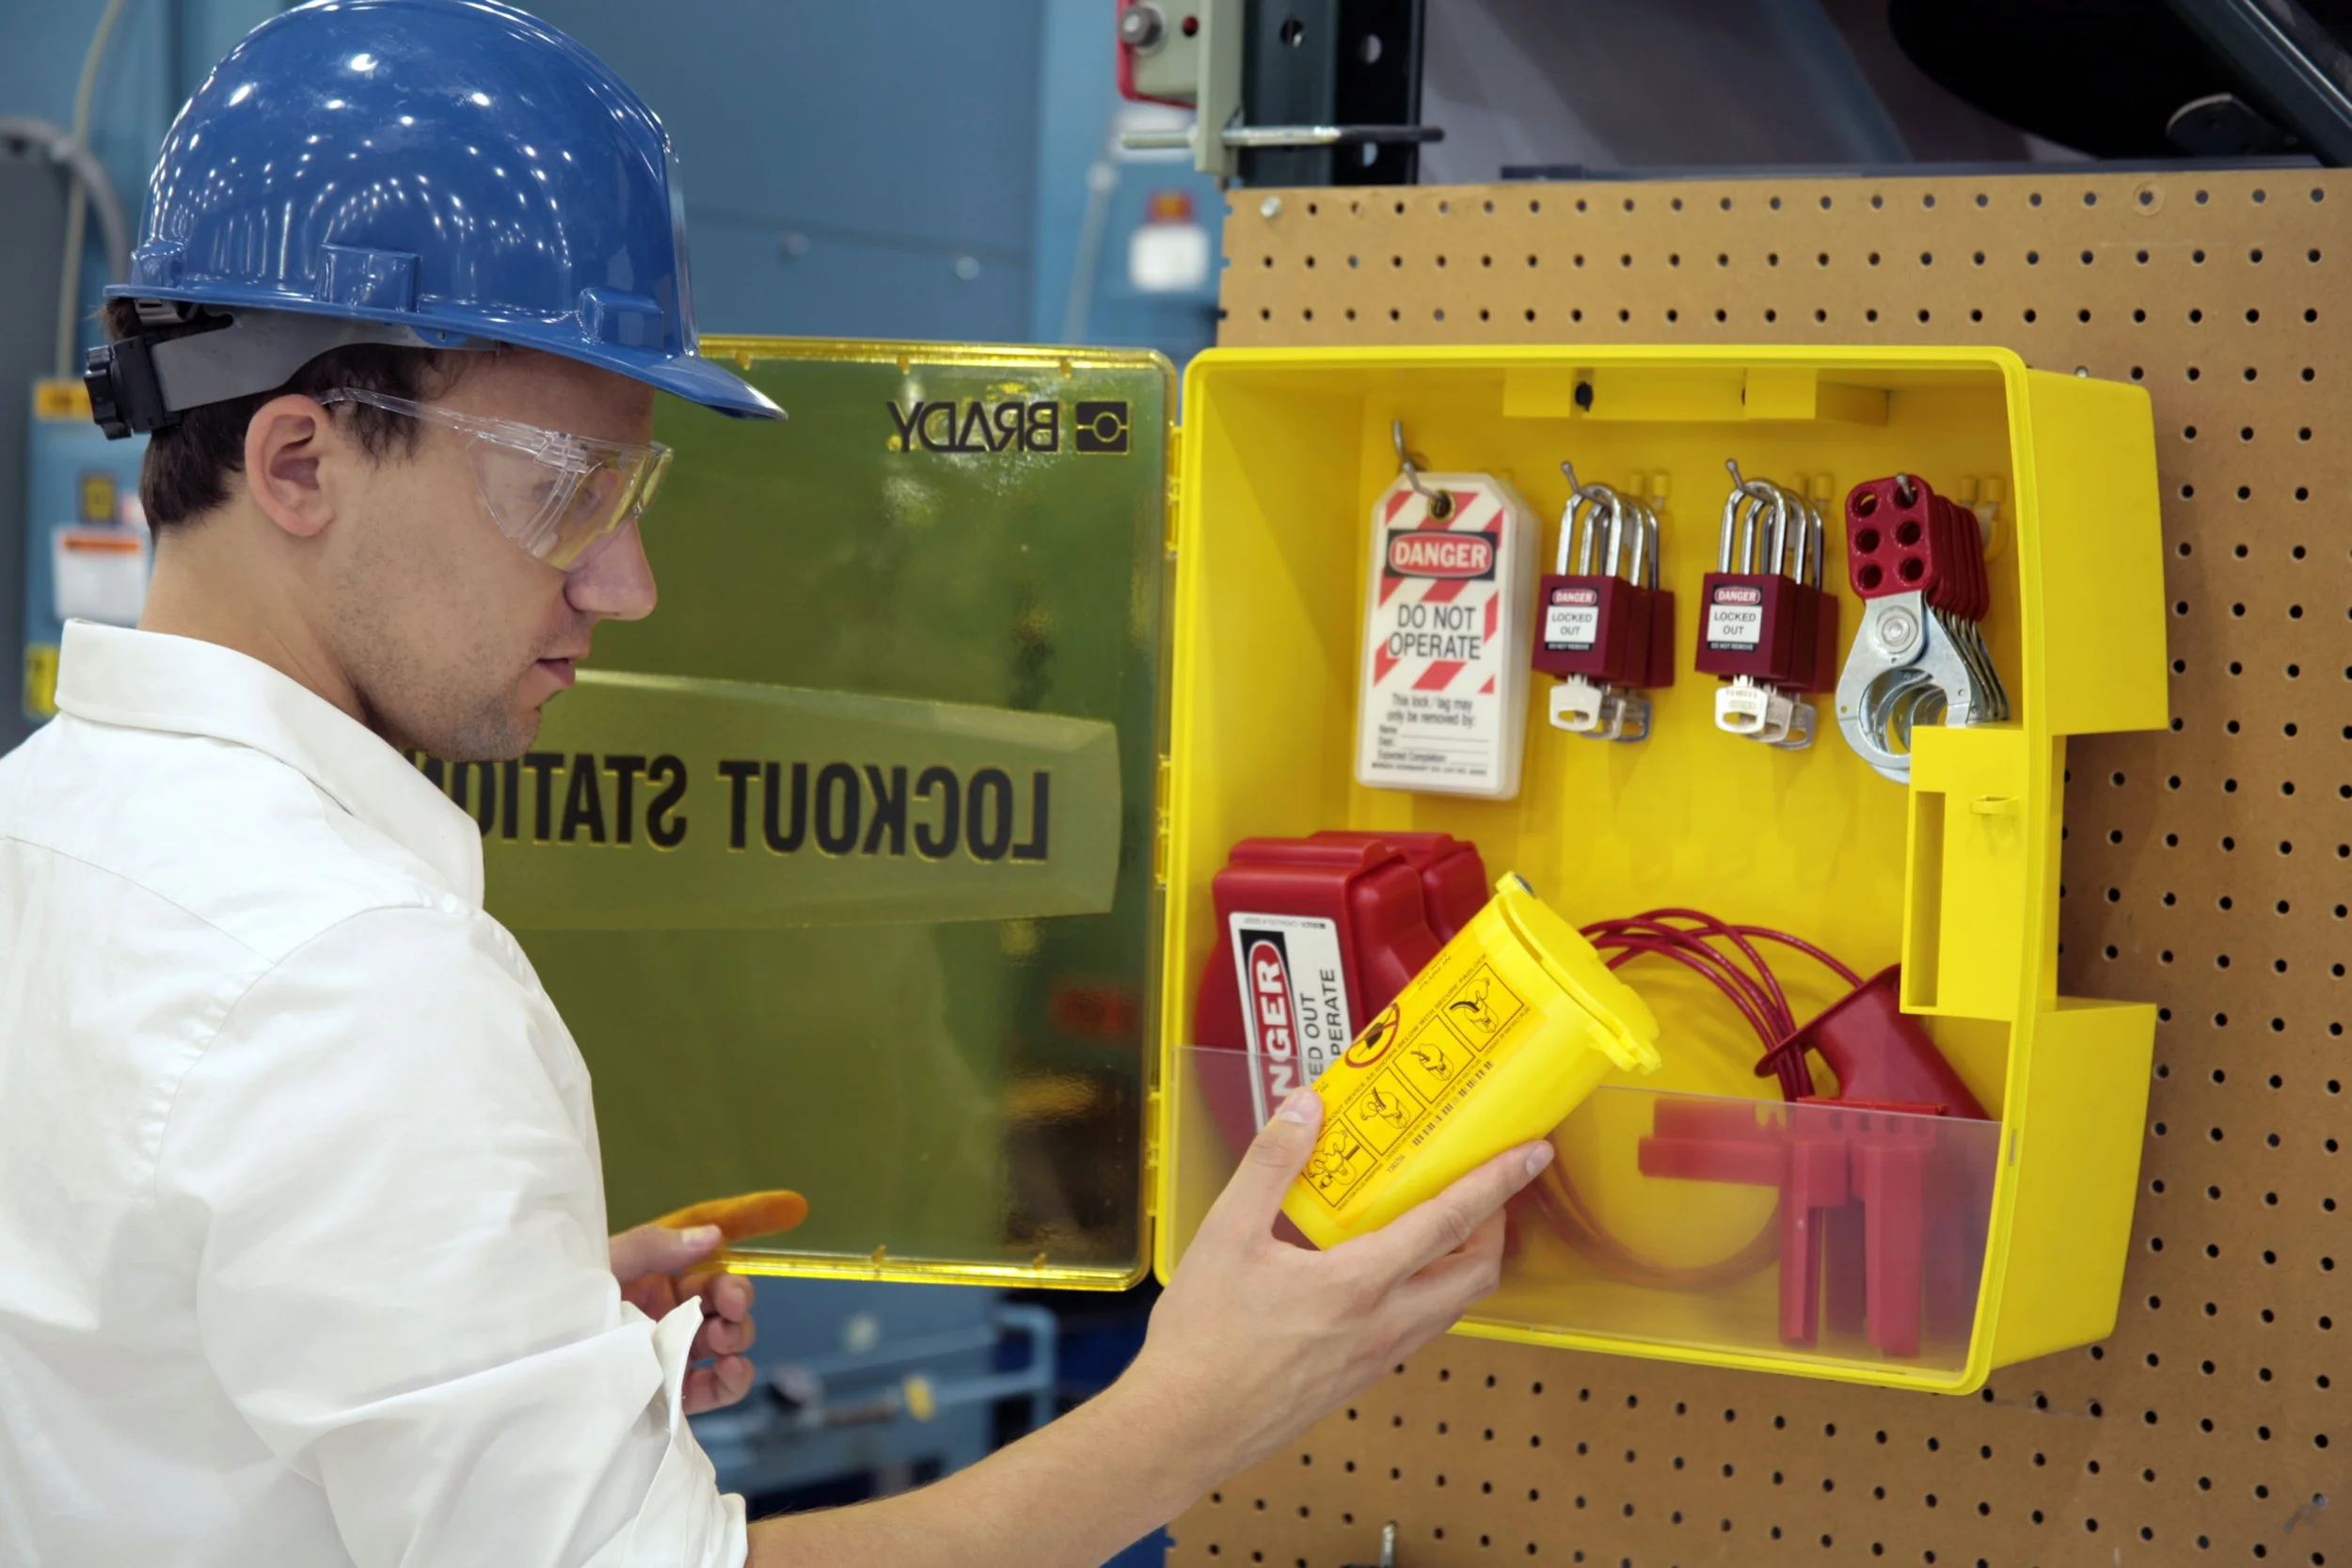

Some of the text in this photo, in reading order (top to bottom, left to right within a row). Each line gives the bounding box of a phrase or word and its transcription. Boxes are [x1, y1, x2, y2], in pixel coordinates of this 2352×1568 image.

[1394, 542, 1487, 568] DANGER
[1556, 592, 1592, 603] DANGER
[1718, 591, 1756, 602] DANGER
[1398, 604, 1476, 630] DO NOT
[1552, 613, 1593, 623] LOCKED
[1714, 612, 1756, 622] LOCKED
[1560, 626, 1581, 635] OUT
[1723, 625, 1744, 635] OUT
[1390, 632, 1481, 659] OPERATE
[1392, 693, 1409, 706] This
[1412, 696, 1428, 707] lock
[1454, 700, 1472, 714] may
[1421, 713, 1459, 725] removed
[1396, 1024, 1420, 1049] BELOW
[1417, 1007, 1436, 1026] WITH
[1456, 952, 1487, 984] PADLOCK
[1300, 992, 1320, 1039] OUT
[1320, 969, 1344, 1057] PERATE
[1256, 959, 1293, 1097] NGER
